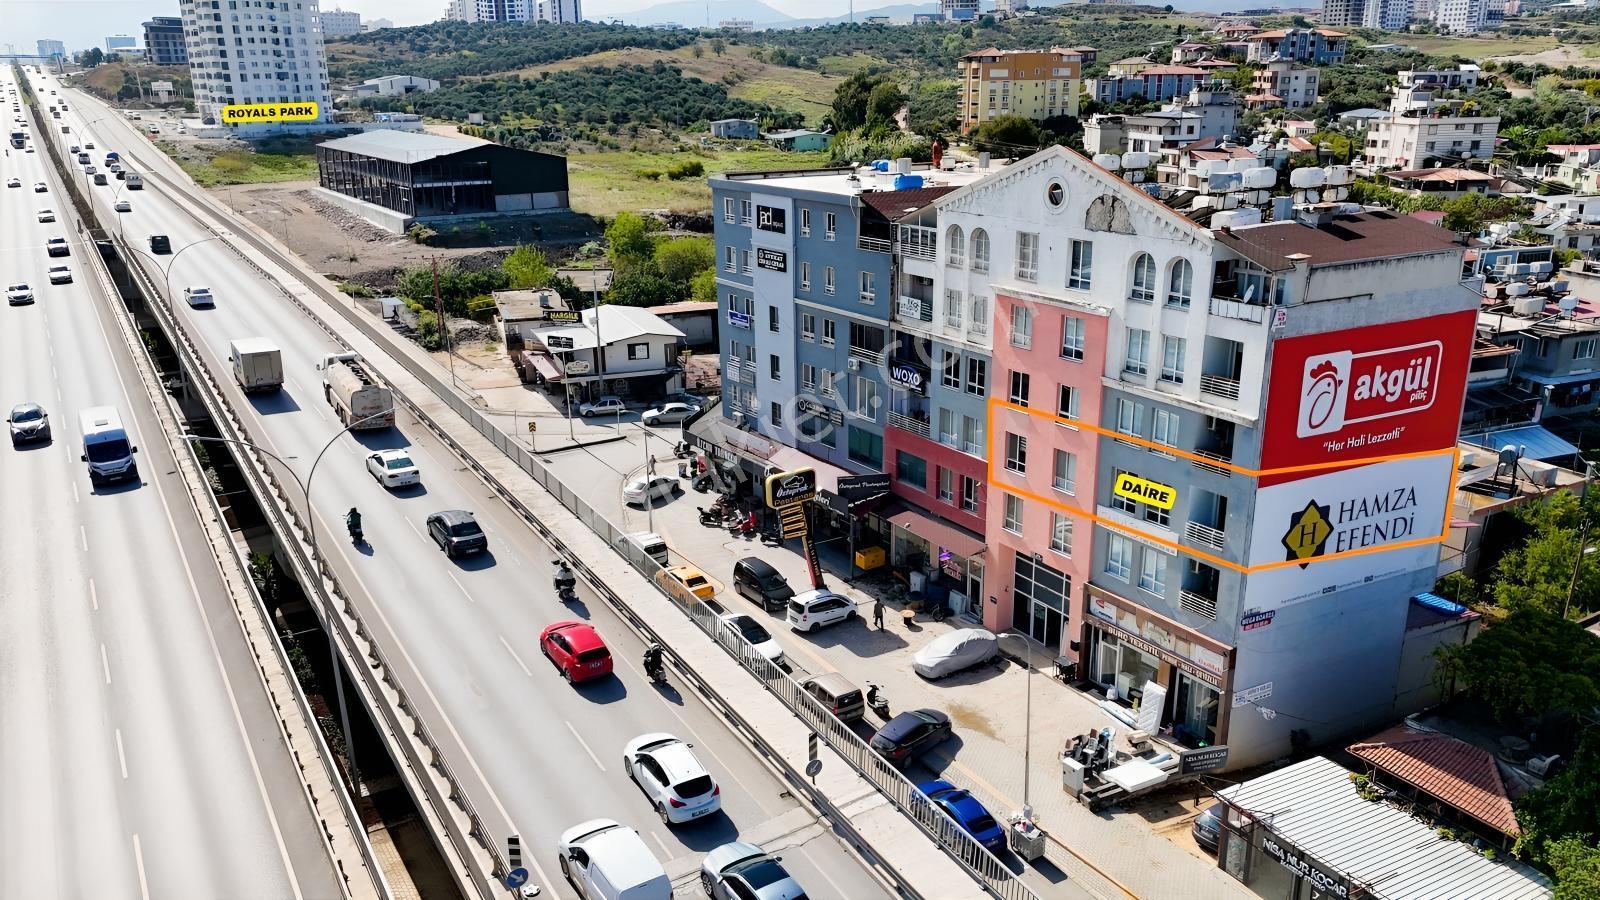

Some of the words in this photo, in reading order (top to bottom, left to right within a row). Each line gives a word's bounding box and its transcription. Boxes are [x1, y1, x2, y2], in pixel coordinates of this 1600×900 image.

[892, 366, 920, 386] WOXO
[1354, 356, 1431, 403] akgül
[1347, 434, 1366, 449] Hali
[1337, 486, 1418, 524] HAMZA
[1298, 521, 1319, 548] H
[1335, 512, 1415, 553] EFENDİ
[1108, 626, 1129, 642] BURÇ
[1286, 852, 1310, 875] NUR
